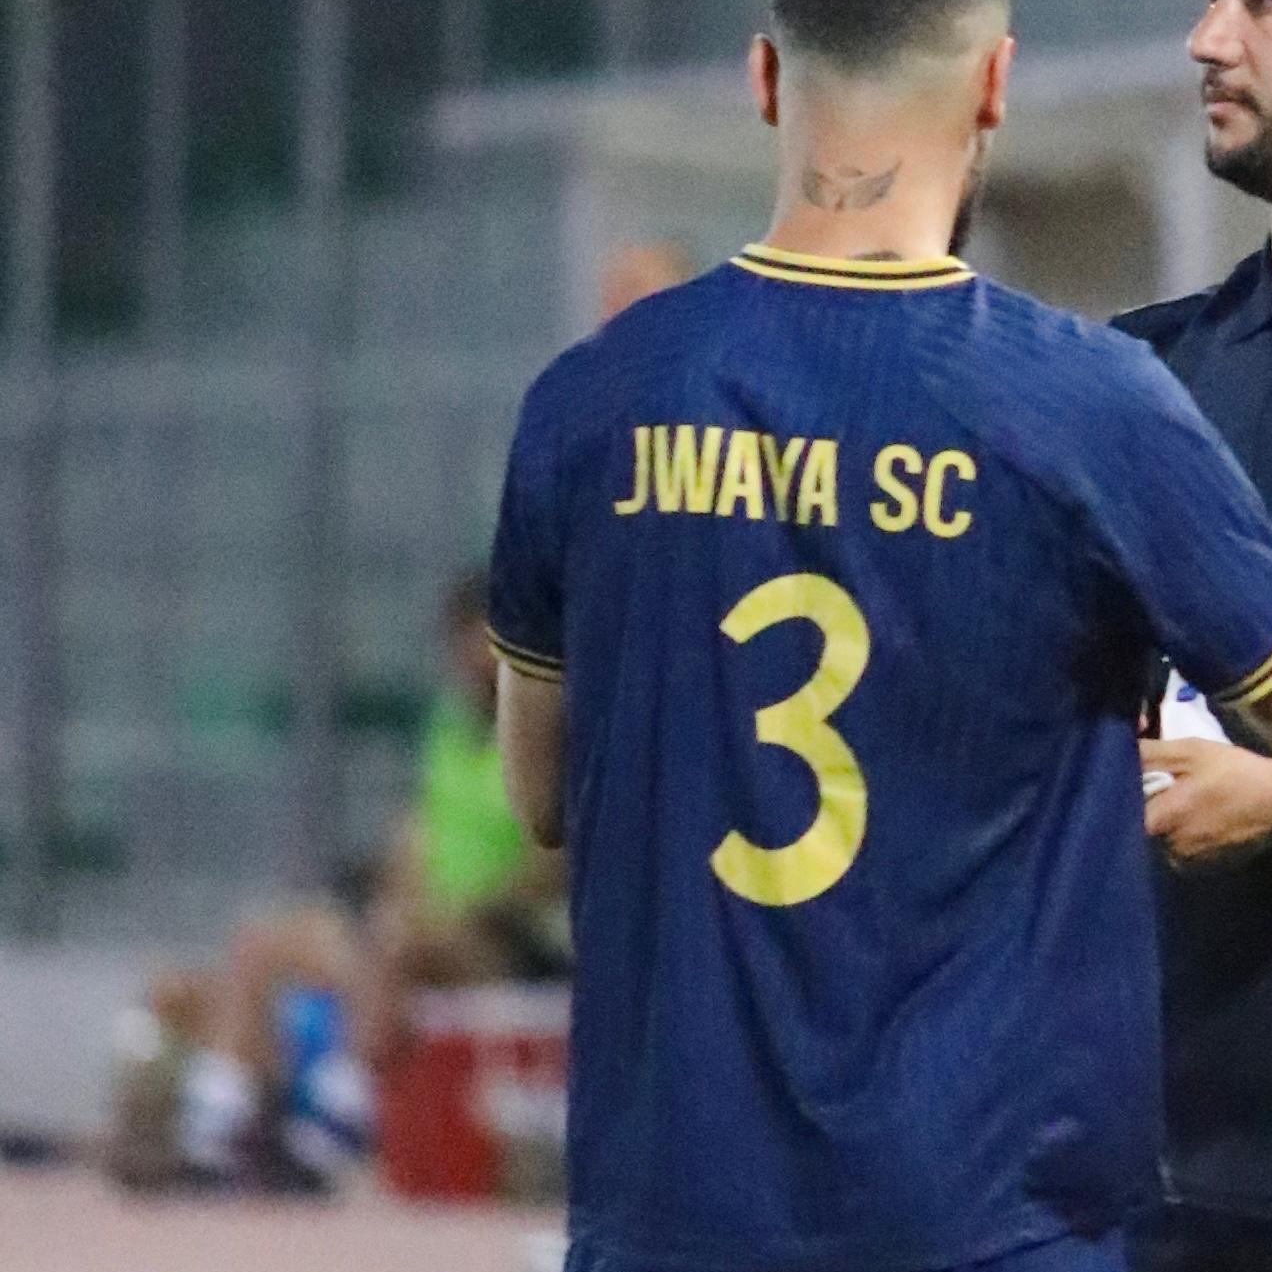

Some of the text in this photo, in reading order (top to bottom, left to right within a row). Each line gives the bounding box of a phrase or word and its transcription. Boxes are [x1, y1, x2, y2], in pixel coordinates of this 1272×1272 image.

[613, 424, 977, 538] JWAYA SC
[710, 573, 871, 906] 3
